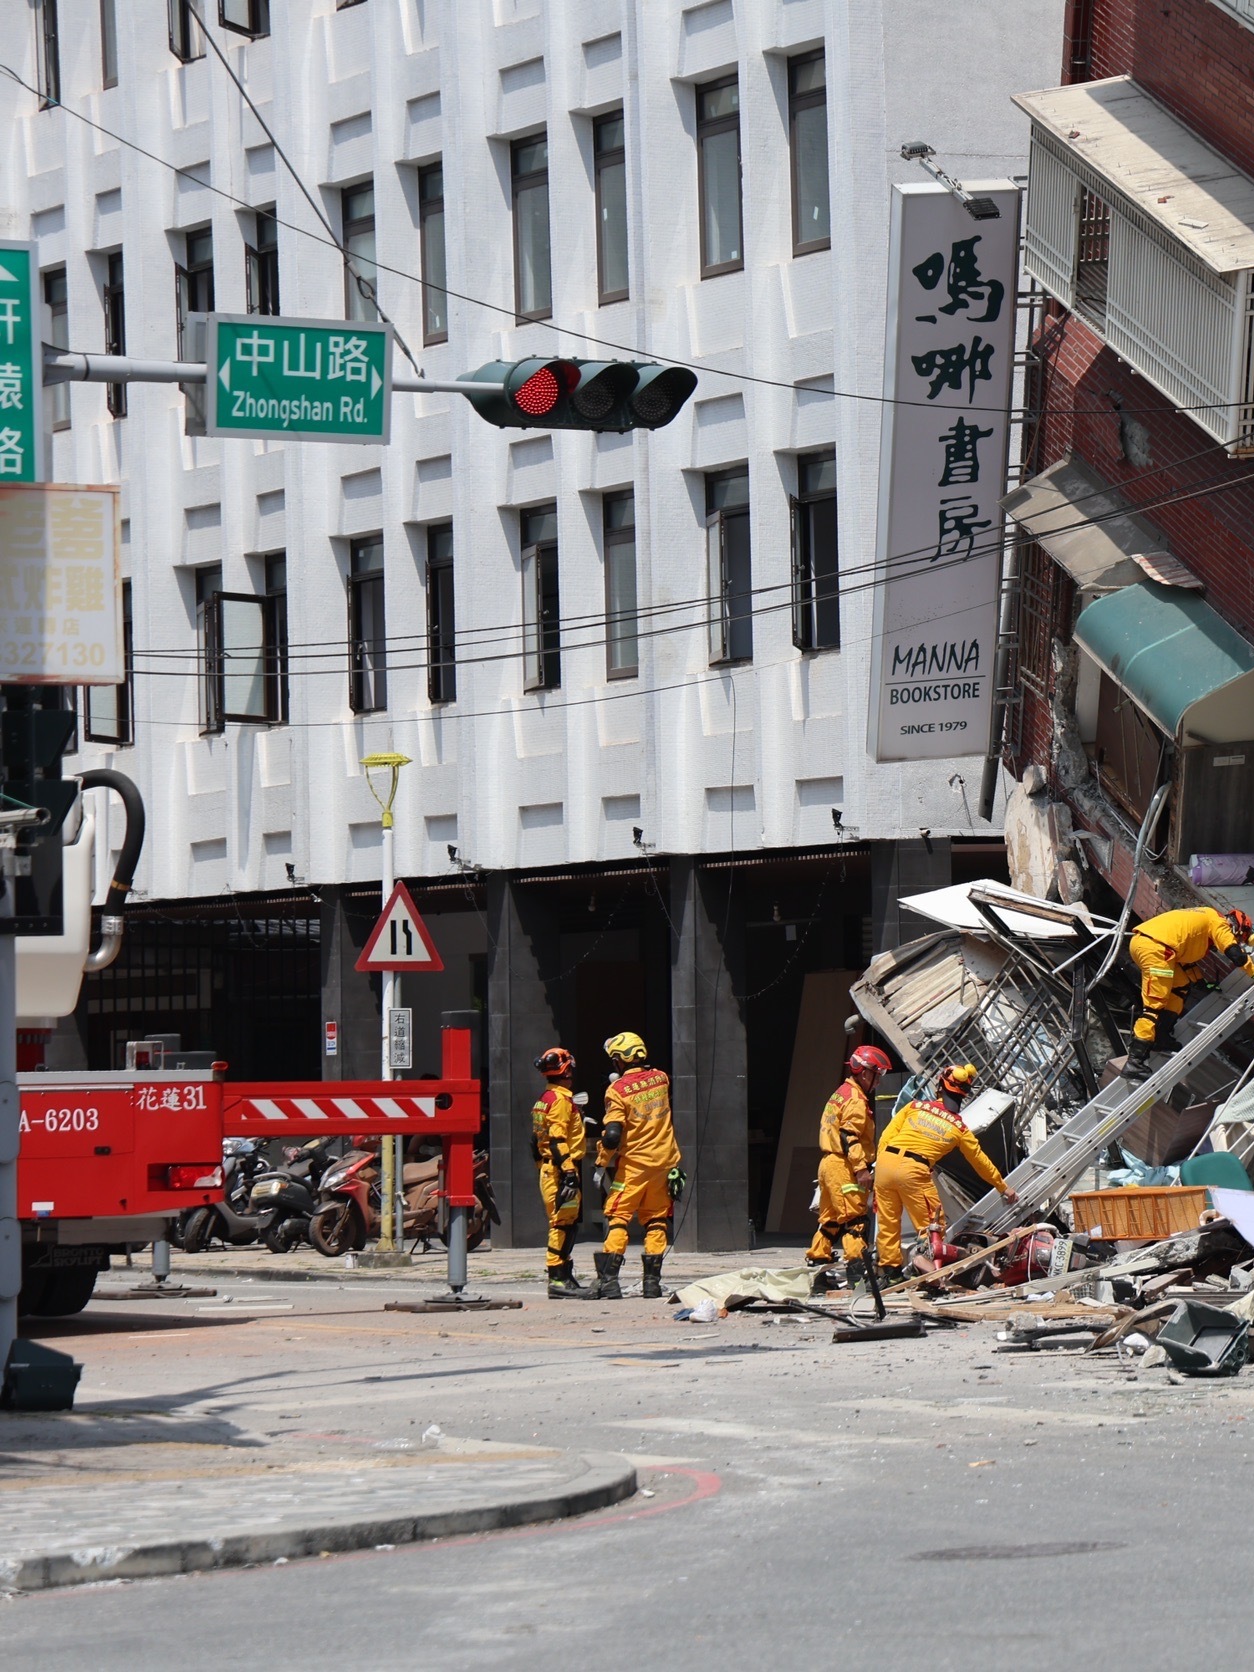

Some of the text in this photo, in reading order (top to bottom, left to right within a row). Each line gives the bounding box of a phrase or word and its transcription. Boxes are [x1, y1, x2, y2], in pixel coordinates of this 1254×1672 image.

[235, 331, 370, 384] 中山路
[232, 391, 368, 428] Zhongshan Rd.
[910, 233, 1004, 563] 嗎哪書房
[0, 641, 105, 667] 327130
[891, 639, 979, 677] MANNA
[889, 682, 980, 706] BOOKSTORE
[899, 720, 968, 736] SINCE 1979
[136, 1084, 207, 1112] 花蓮31
[19, 1108, 99, 1132] A-6203
